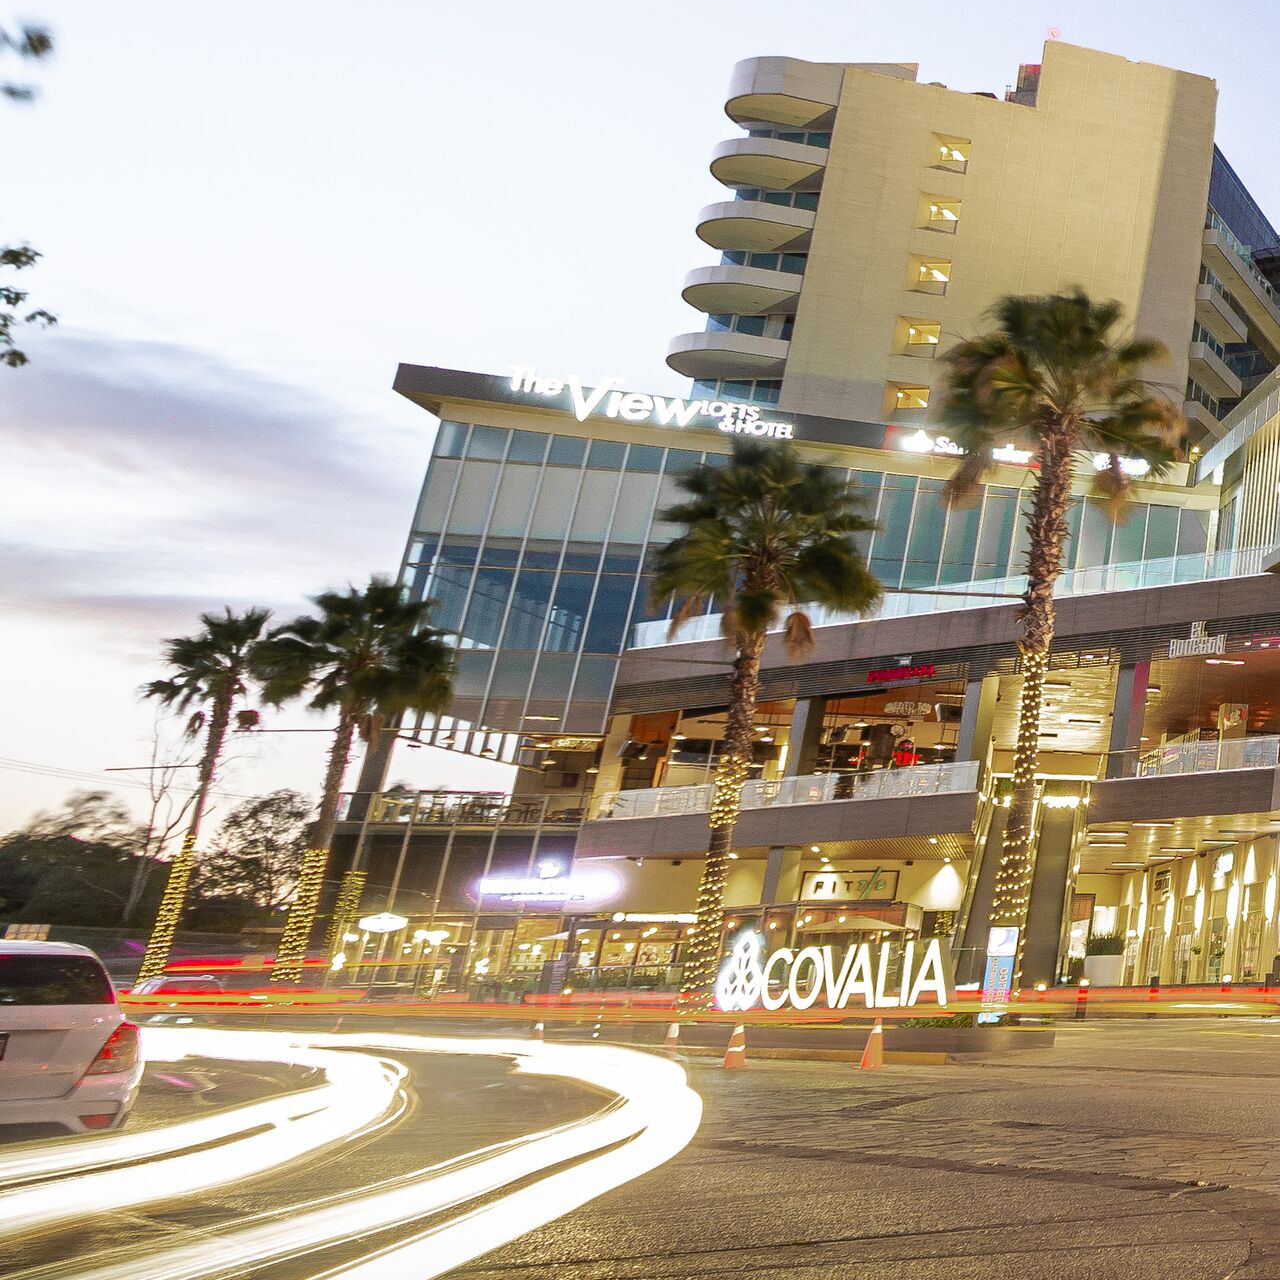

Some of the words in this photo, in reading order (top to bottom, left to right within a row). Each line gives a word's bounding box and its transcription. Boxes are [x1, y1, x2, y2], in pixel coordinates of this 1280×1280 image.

[509, 365, 563, 397] The
[567, 373, 703, 427] View
[700, 400, 760, 421] LOFTS
[1191, 621, 1209, 638] EL
[760, 939, 948, 1010] COVALIA
